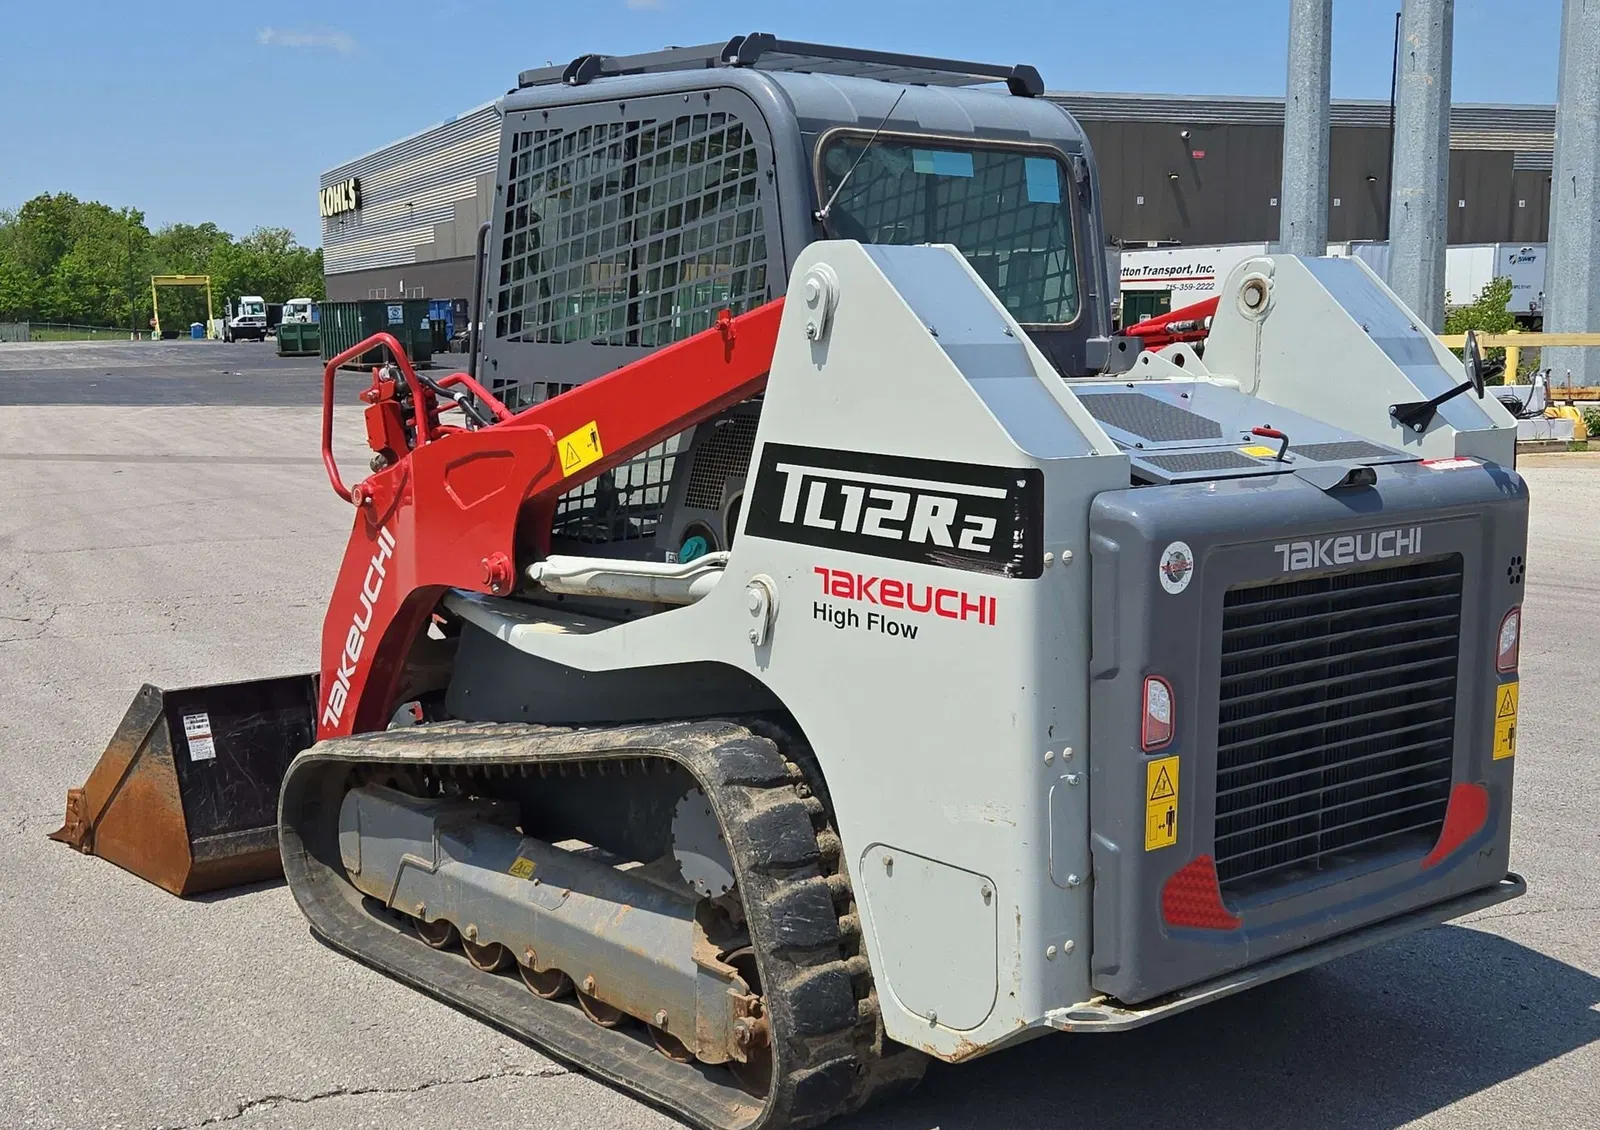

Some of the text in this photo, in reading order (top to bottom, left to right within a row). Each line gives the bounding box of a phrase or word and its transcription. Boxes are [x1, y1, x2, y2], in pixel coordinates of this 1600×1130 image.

[319, 177, 356, 217] KOHL'S
[1120, 263, 1215, 277] tton Transport, Inc.
[1165, 283, 1215, 291] 715-359-2222
[775, 462, 1008, 553] TL12R2
[1274, 527, 1422, 572] TAKEUCHI
[814, 566, 997, 626] TAKEUCHI
[322, 525, 396, 728] TAKEUCHI
[813, 601, 919, 640] High Flow
